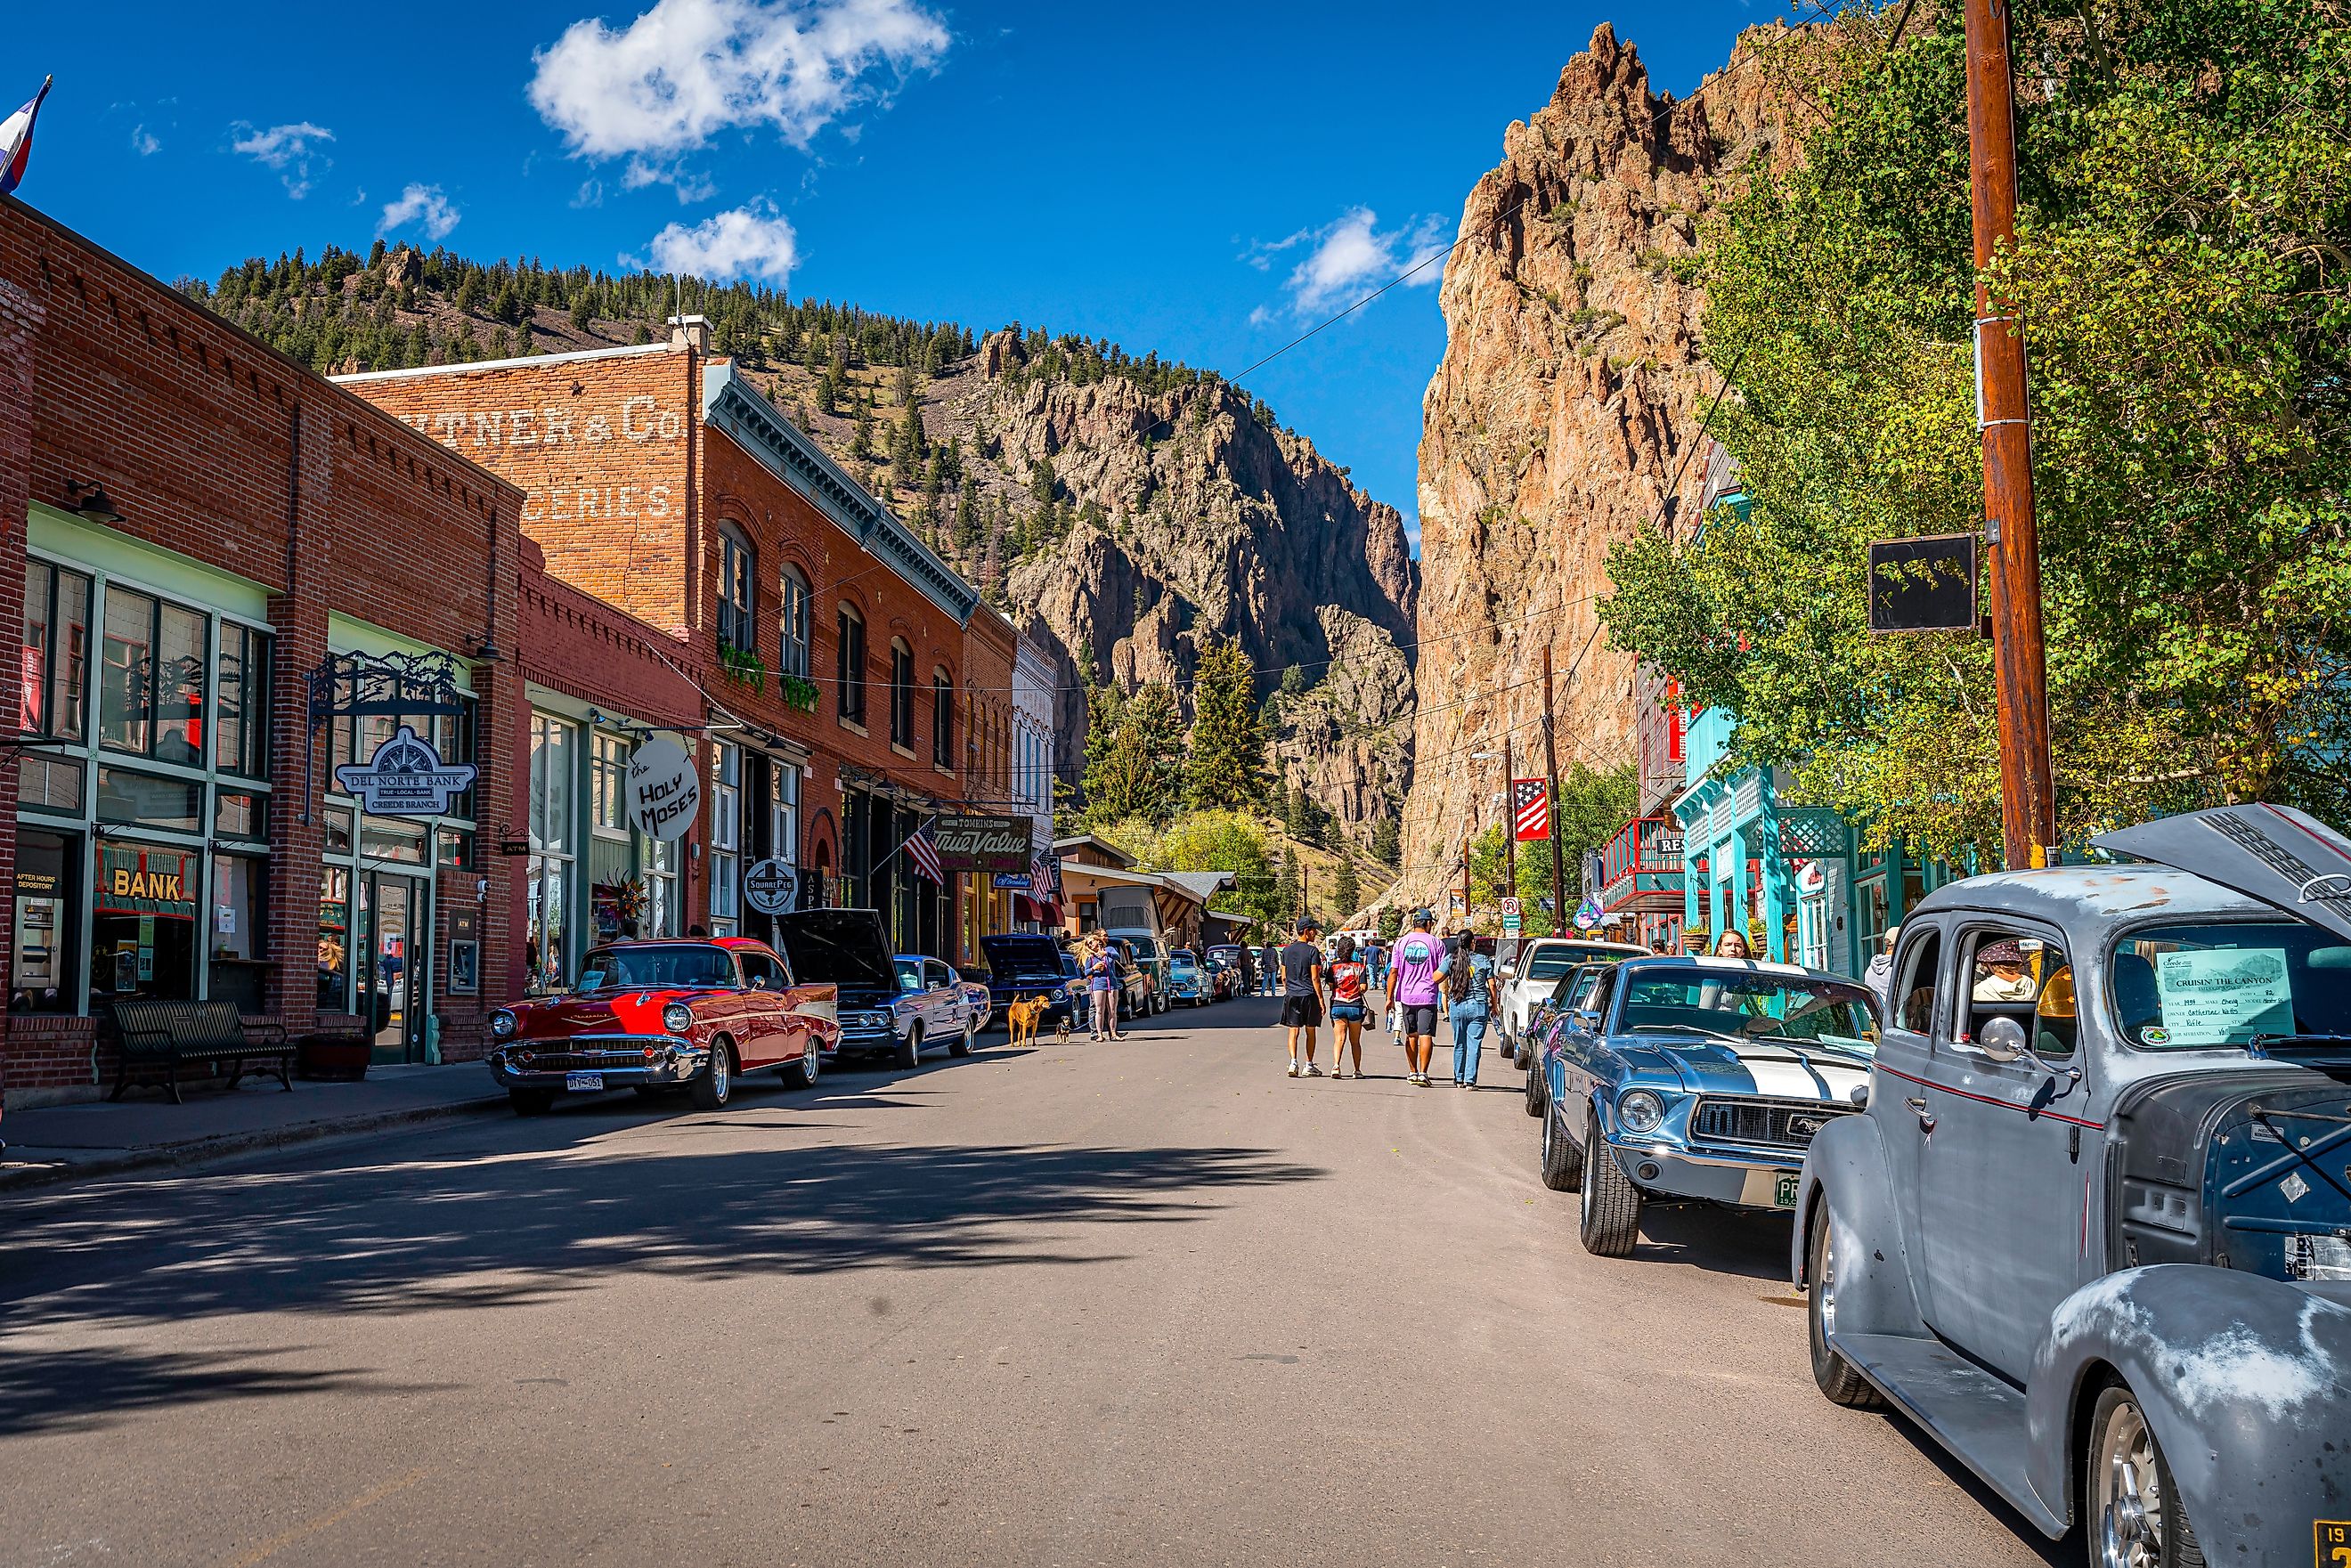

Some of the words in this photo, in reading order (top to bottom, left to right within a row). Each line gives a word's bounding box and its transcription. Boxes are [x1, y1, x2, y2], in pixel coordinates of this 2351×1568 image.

[584, 415, 613, 441] &
[631, 762, 650, 779] the
[351, 776, 374, 786] DEL
[378, 776, 419, 786] NORTE
[427, 776, 461, 786] BANK
[639, 772, 682, 805] HOLY
[371, 800, 404, 808] CREEDE
[405, 800, 440, 808] BRANCH
[640, 784, 697, 838] MOSES
[958, 818, 994, 828] TOMKINS
[962, 832, 1027, 855] Value
[16, 873, 36, 882] AFTER
[37, 874, 56, 883] HOURS
[18, 881, 53, 890] DEPOSITORY
[113, 869, 181, 901] BANK
[2233, 977, 2273, 985] CANYON
[2328, 1527, 2345, 1542] 19
